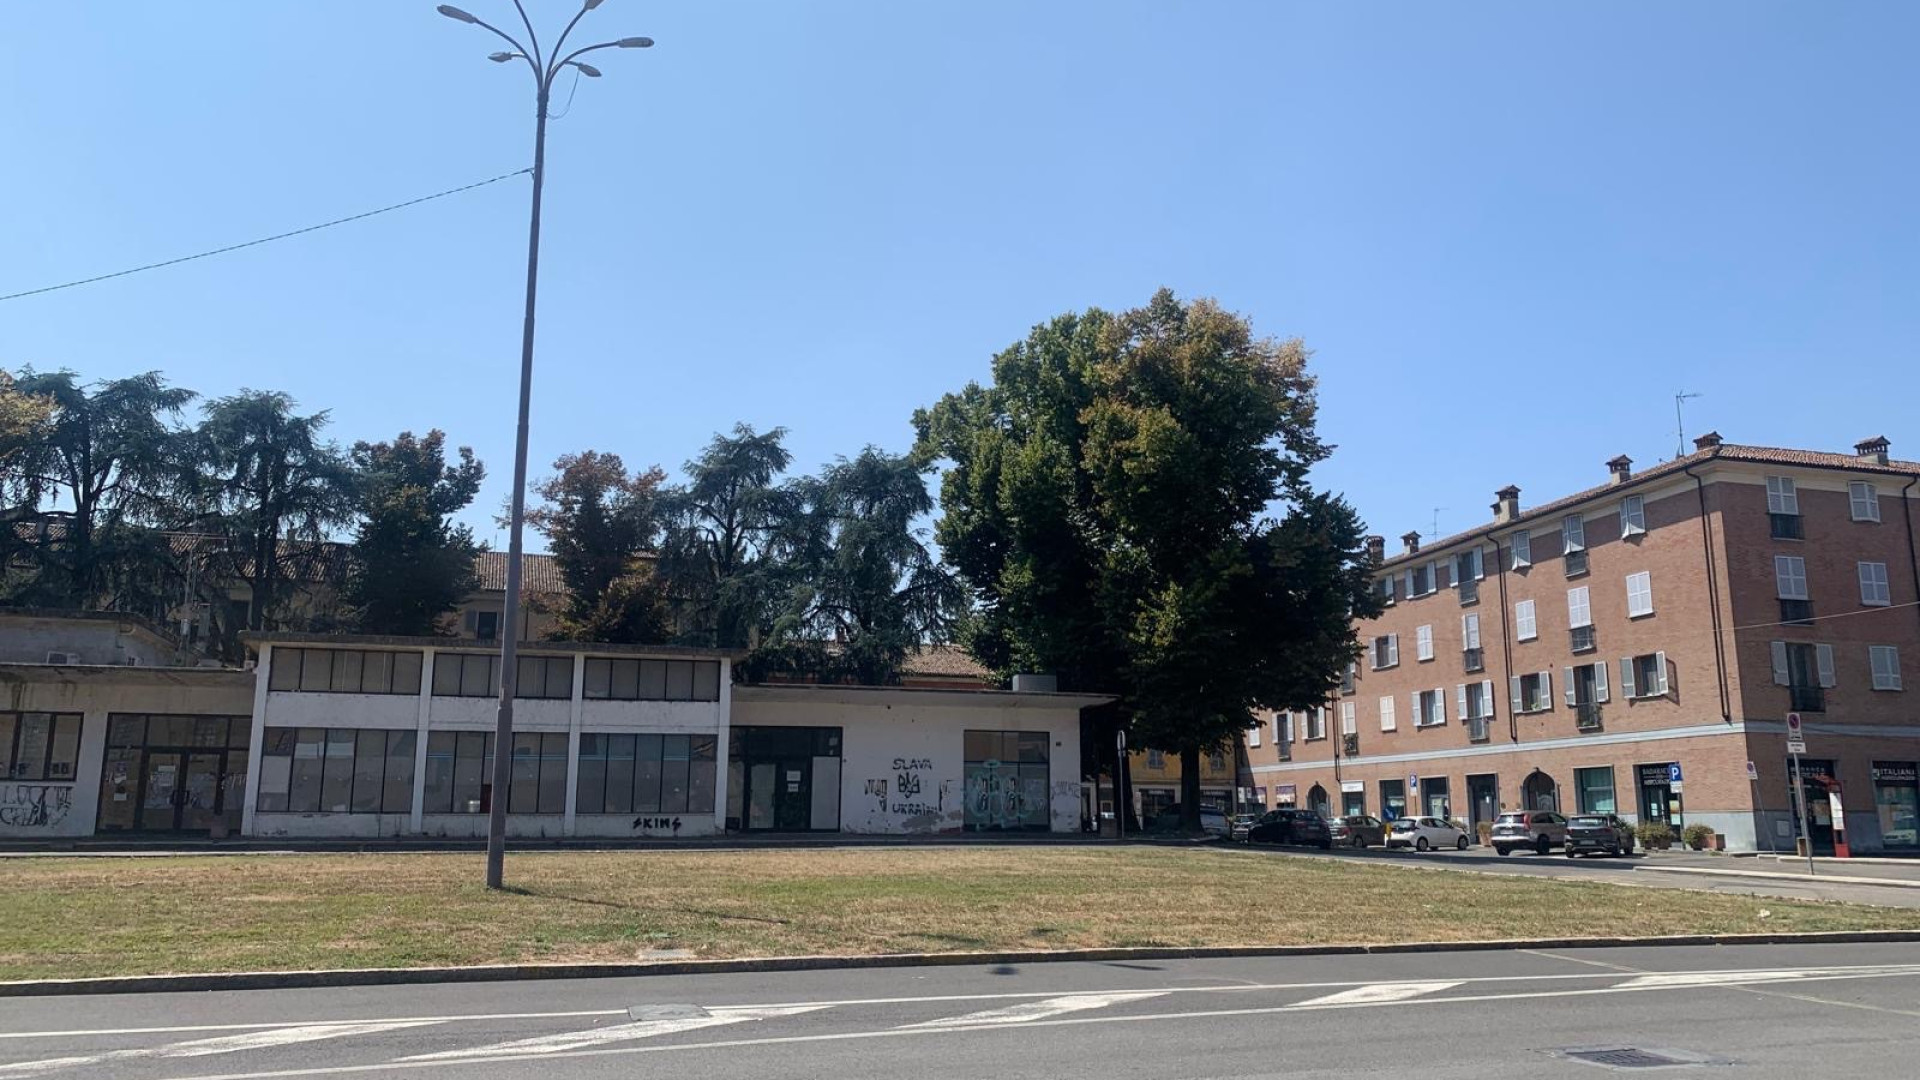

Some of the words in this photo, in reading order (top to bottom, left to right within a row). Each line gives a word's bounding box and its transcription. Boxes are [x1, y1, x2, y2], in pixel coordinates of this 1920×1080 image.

[892, 758, 932, 770] SLAVA
[1671, 767, 1680, 780] P
[633, 816, 682, 832] SKINS
